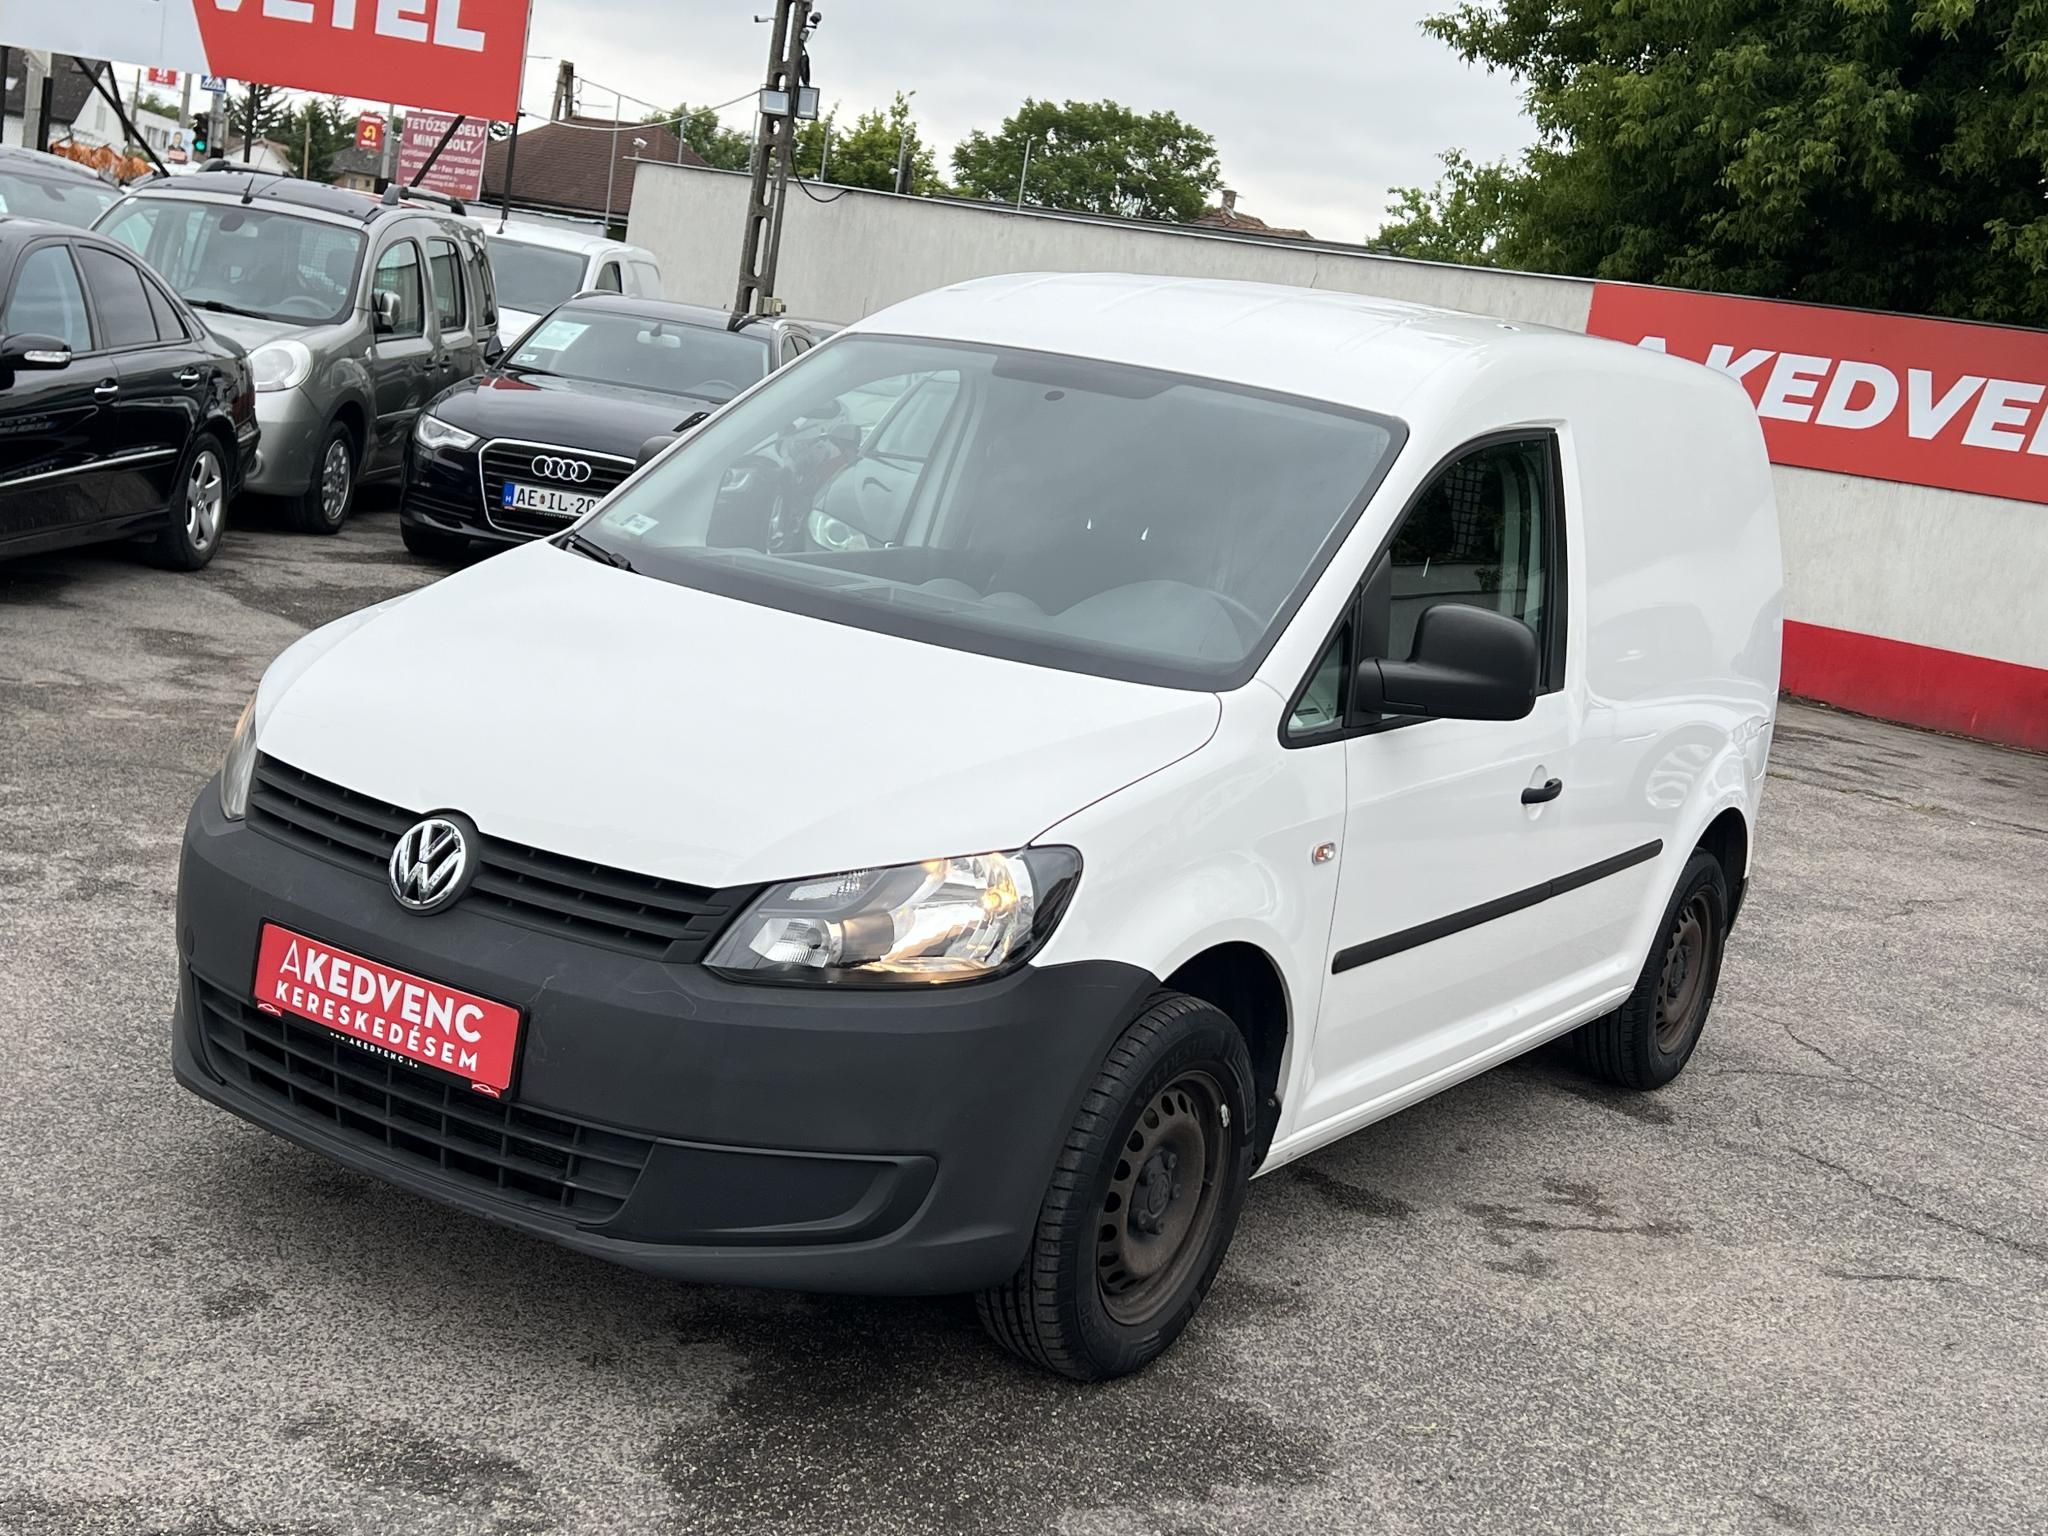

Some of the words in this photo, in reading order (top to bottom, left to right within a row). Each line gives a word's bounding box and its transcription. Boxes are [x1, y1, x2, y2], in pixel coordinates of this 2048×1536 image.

[406, 116, 485, 139] TETŐZSDELY
[413, 133, 474, 152] MINTBOLT
[1704, 344, 2048, 456] KEDVE
[516, 488, 538, 507] AE
[547, 492, 601, 514] IL-20
[279, 939, 485, 1043] AKEDVENC
[275, 980, 478, 1072] KERESKEDÉSEM
